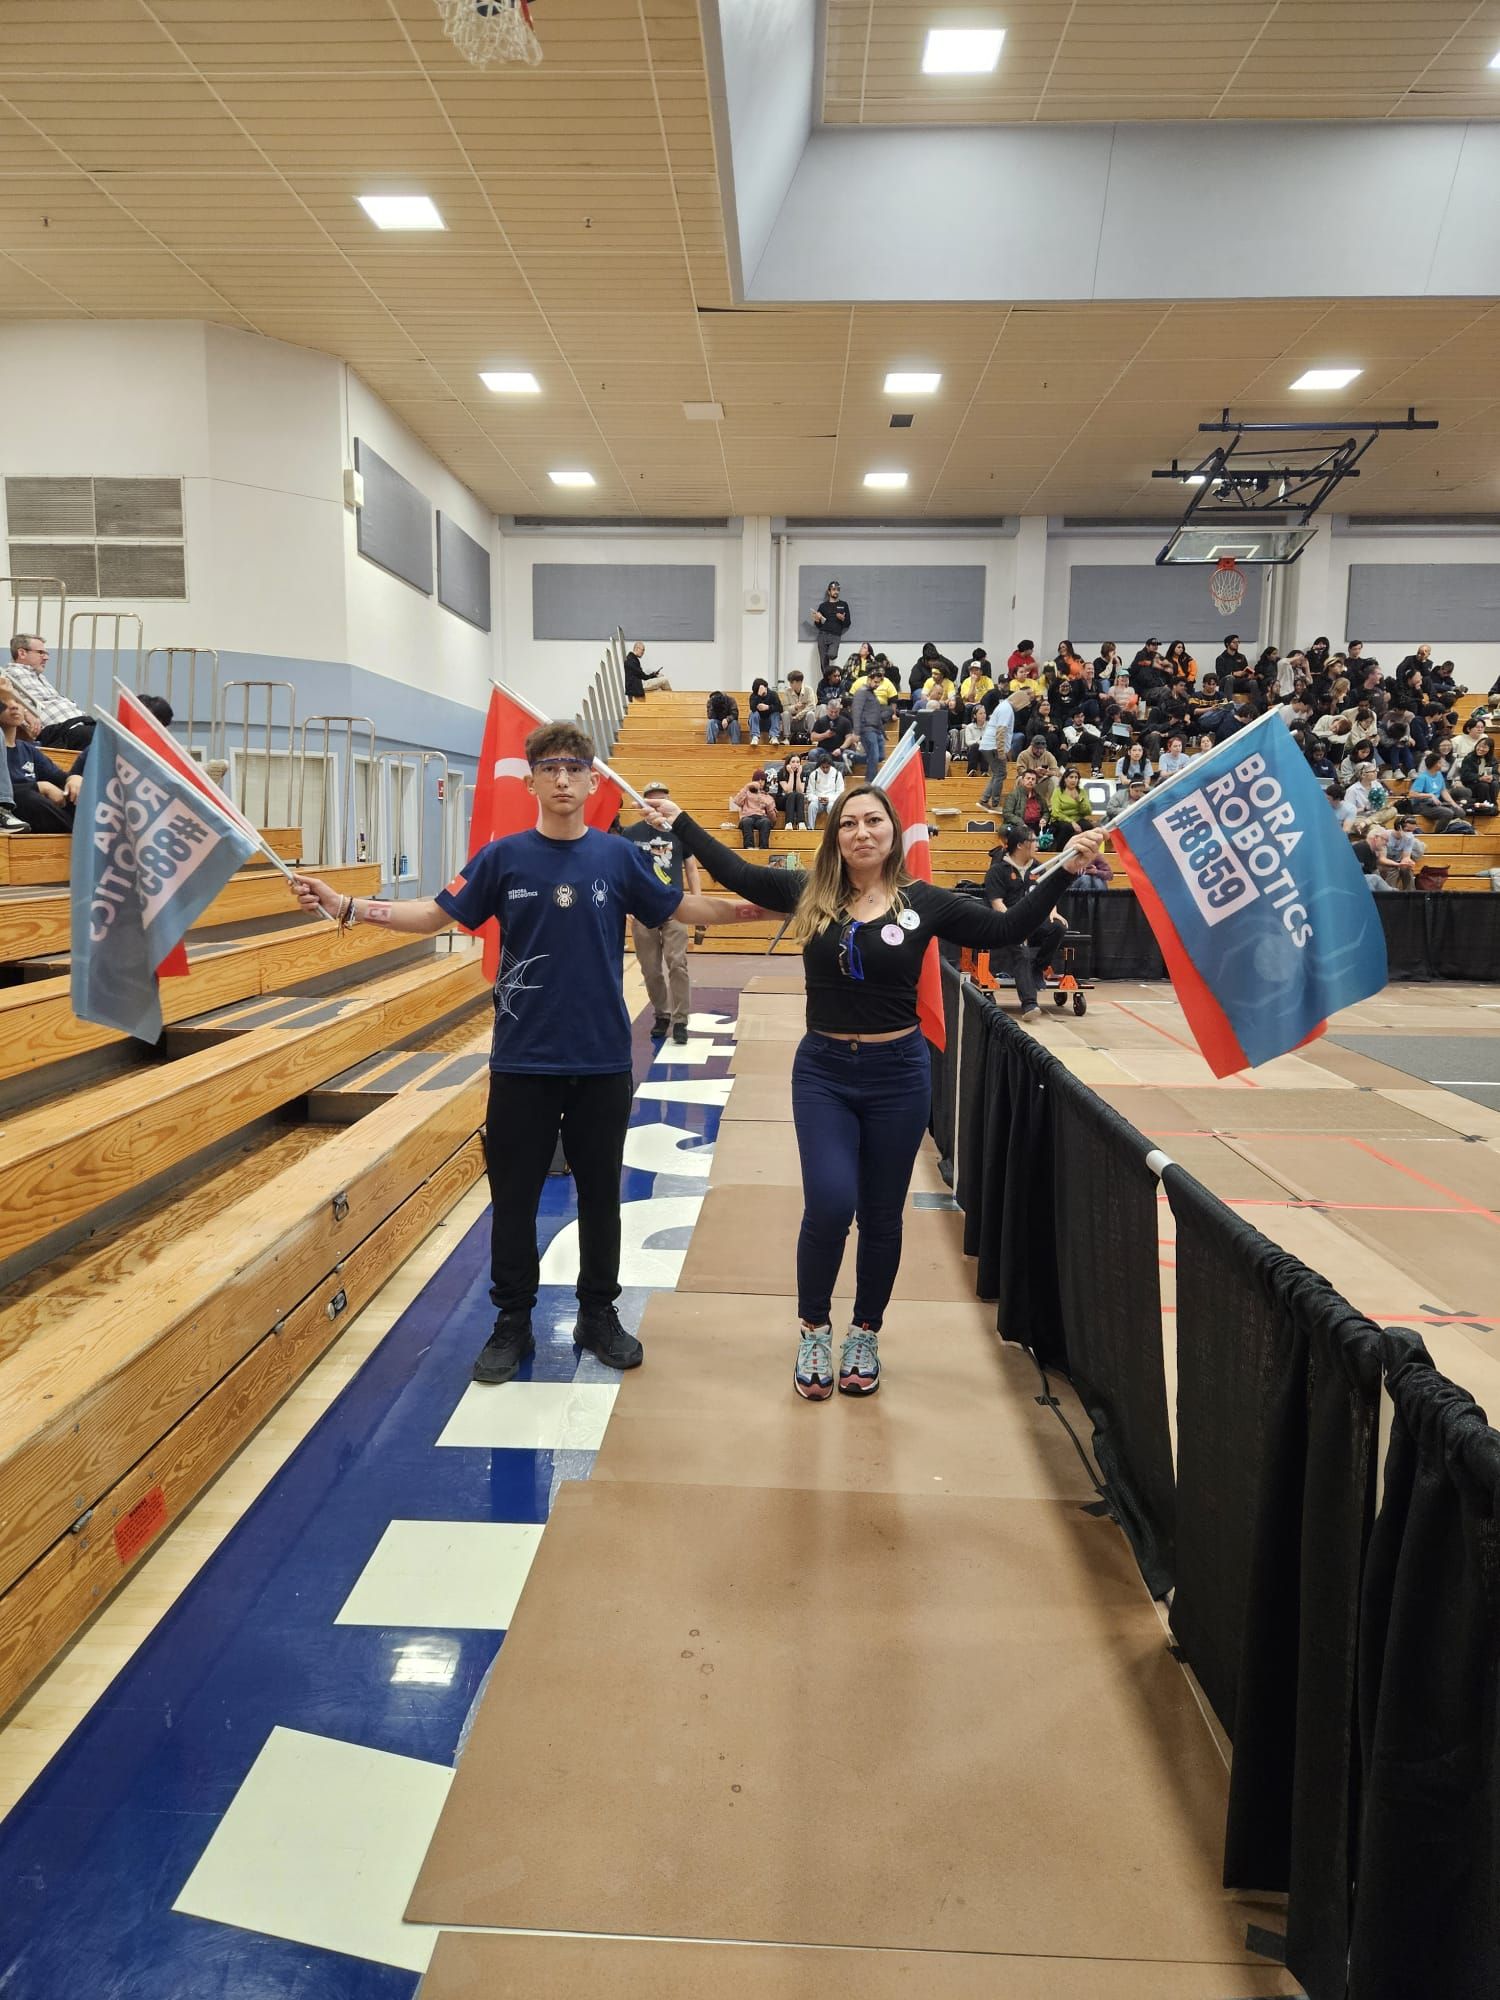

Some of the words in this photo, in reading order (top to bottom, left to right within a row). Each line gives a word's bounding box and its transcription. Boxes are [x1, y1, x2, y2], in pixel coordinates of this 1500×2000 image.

[1165, 805, 1246, 909] #8859
[1234, 752, 1304, 857] BORA
[1205, 772, 1313, 948] ROBOTICS
